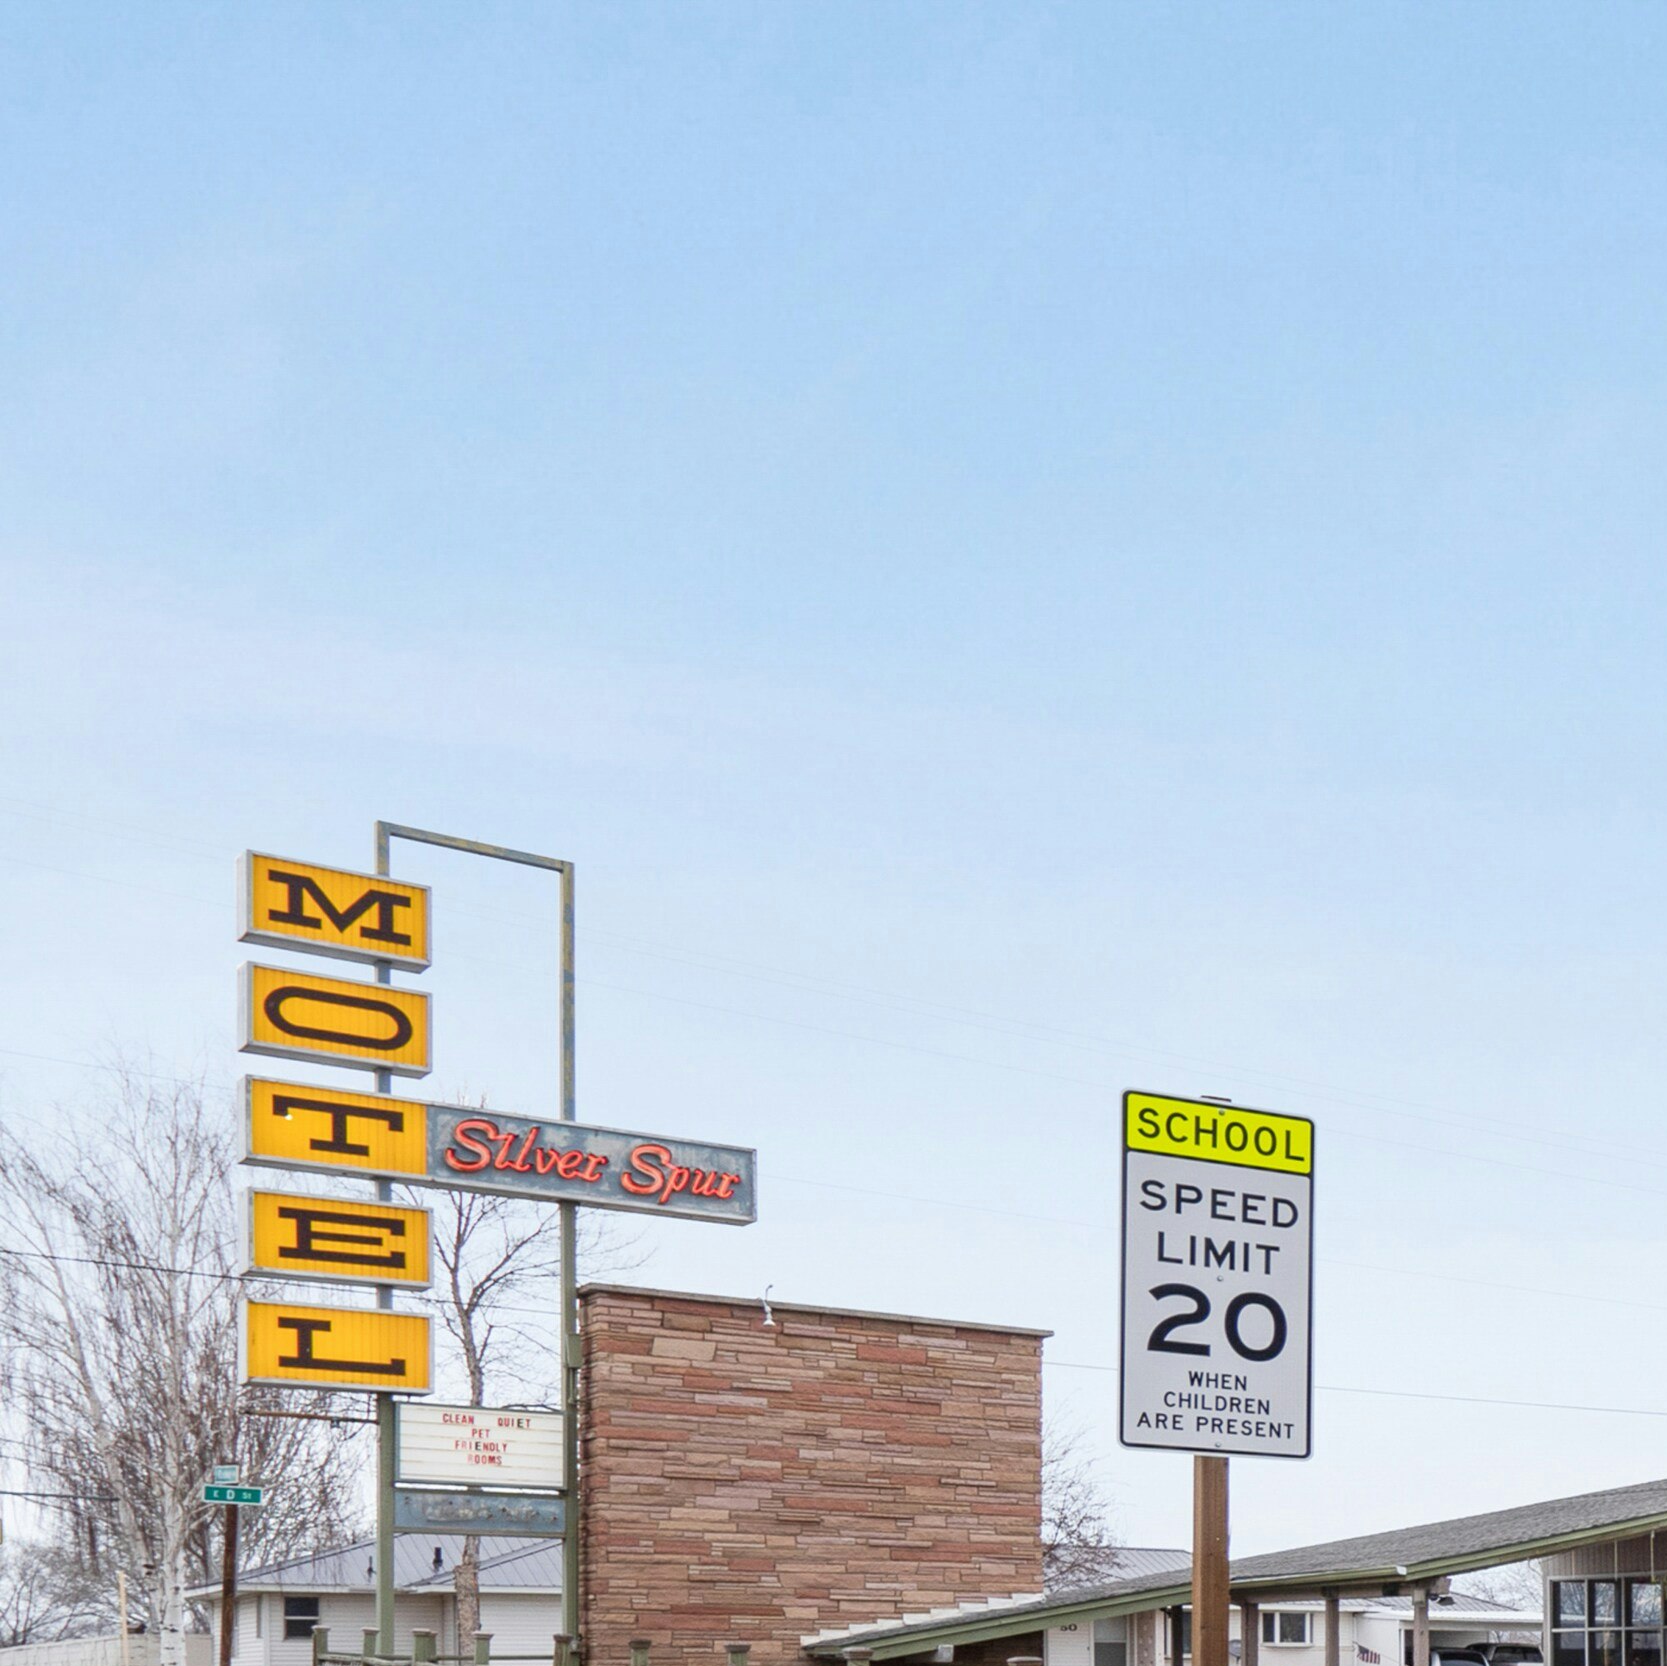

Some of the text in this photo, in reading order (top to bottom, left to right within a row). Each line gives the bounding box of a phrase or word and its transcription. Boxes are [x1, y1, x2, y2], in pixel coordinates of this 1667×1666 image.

[263, 869, 413, 1375] MOTEL
[1137, 1107, 1305, 1162] SCHOOL
[444, 1118, 741, 1204] Silver Spur
[1139, 1179, 1299, 1228] SPEED
[1156, 1231, 1281, 1276] LIMIT
[1146, 1282, 1288, 1362] 20
[1188, 1369, 1248, 1392] WHEN
[1163, 1391, 1271, 1415] CHILDREN
[442, 1413, 532, 1429] CLEAN QUIET
[471, 1428, 491, 1439] PET
[1136, 1411, 1296, 1440] ARE PRESENT
[454, 1440, 508, 1453] FRIENDLY
[467, 1454, 503, 1466] ROOMS
[226, 1489, 235, 1500] D
[242, 1491, 252, 1500] St
